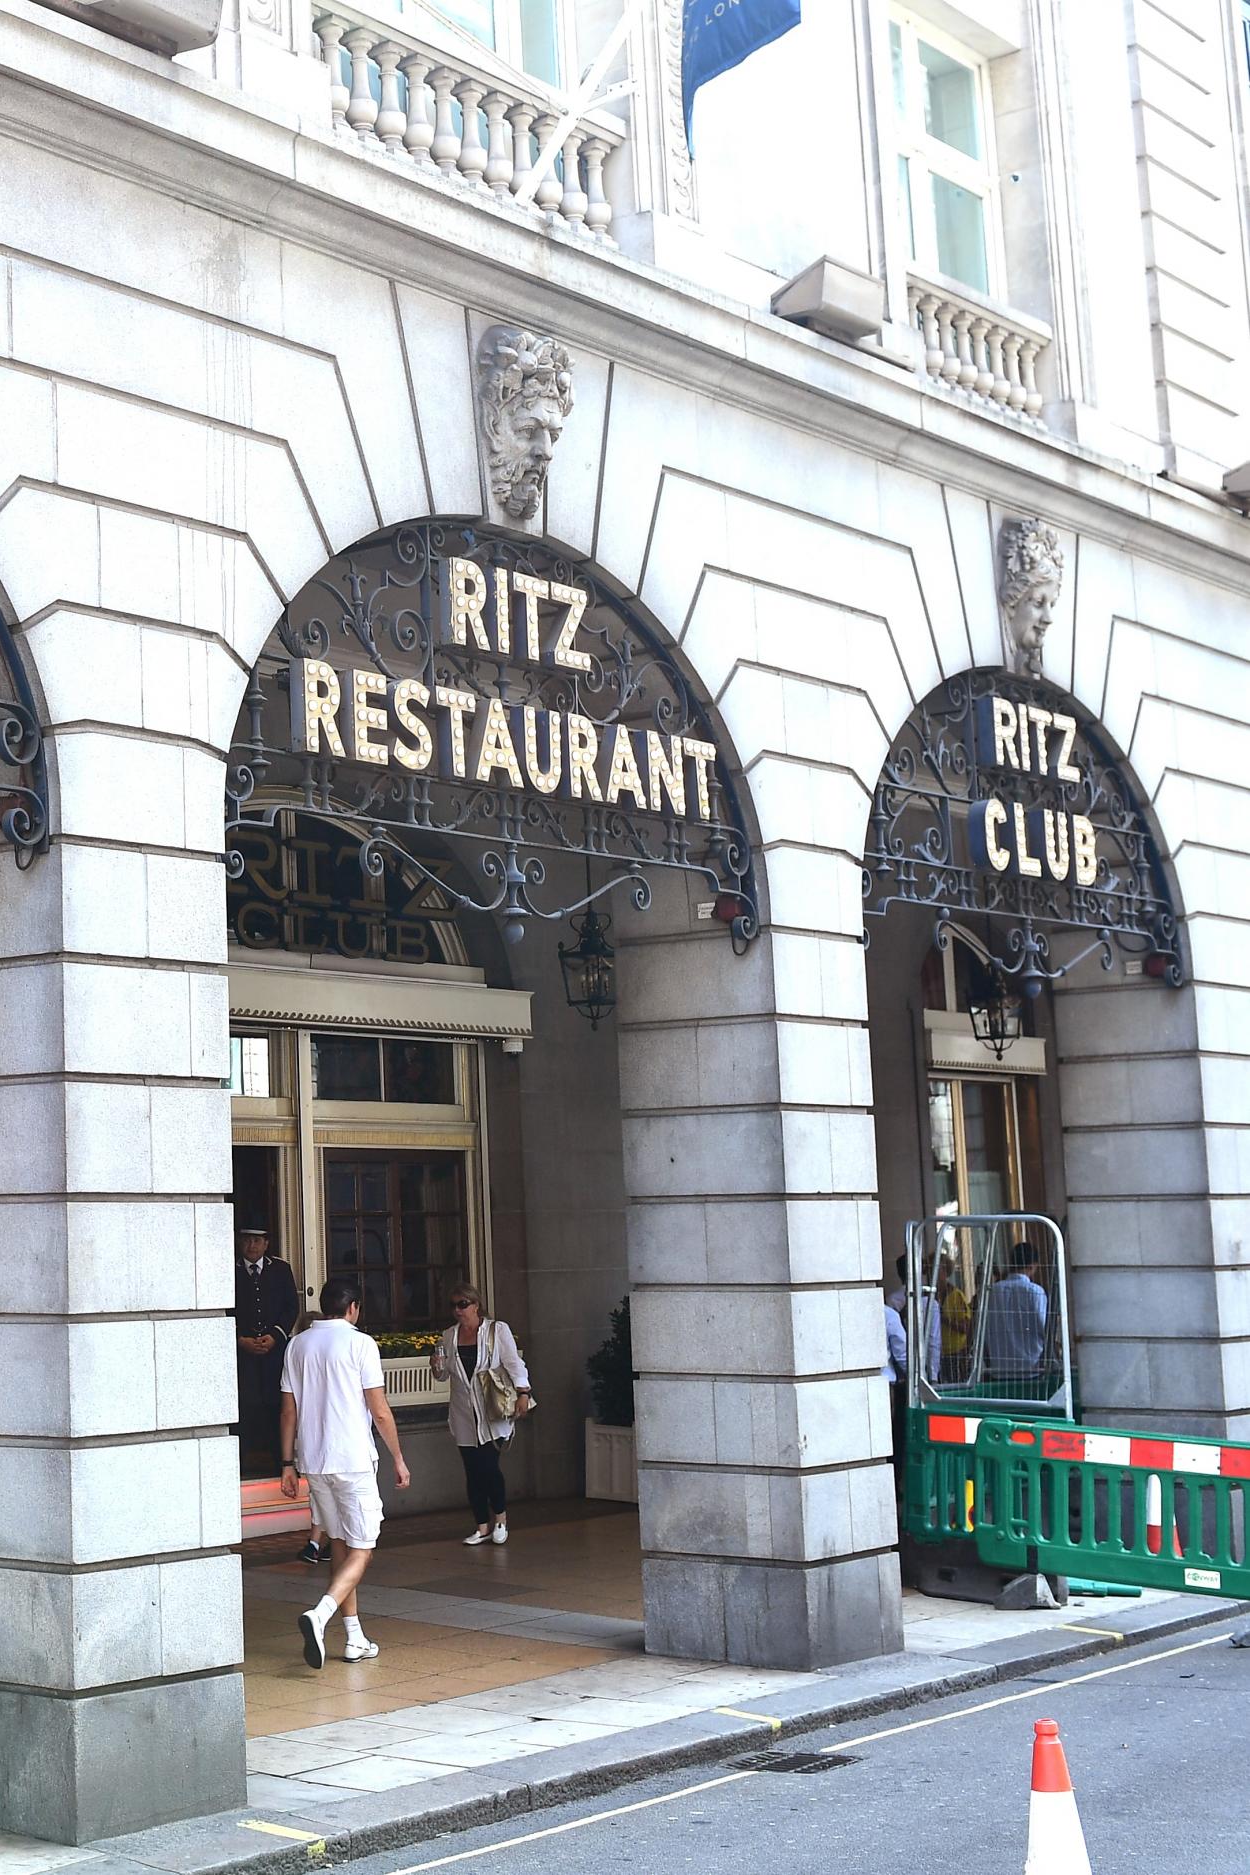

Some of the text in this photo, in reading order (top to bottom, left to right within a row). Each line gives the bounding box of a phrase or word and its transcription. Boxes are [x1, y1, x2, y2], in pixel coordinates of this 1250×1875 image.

[450, 556, 591, 671] RITZ
[302, 657, 717, 820] RESTAURANT
[992, 696, 1080, 783] RITZ
[226, 830, 458, 921] RITZ
[985, 798, 1096, 886] CLUB
[237, 901, 430, 964] CLUB
